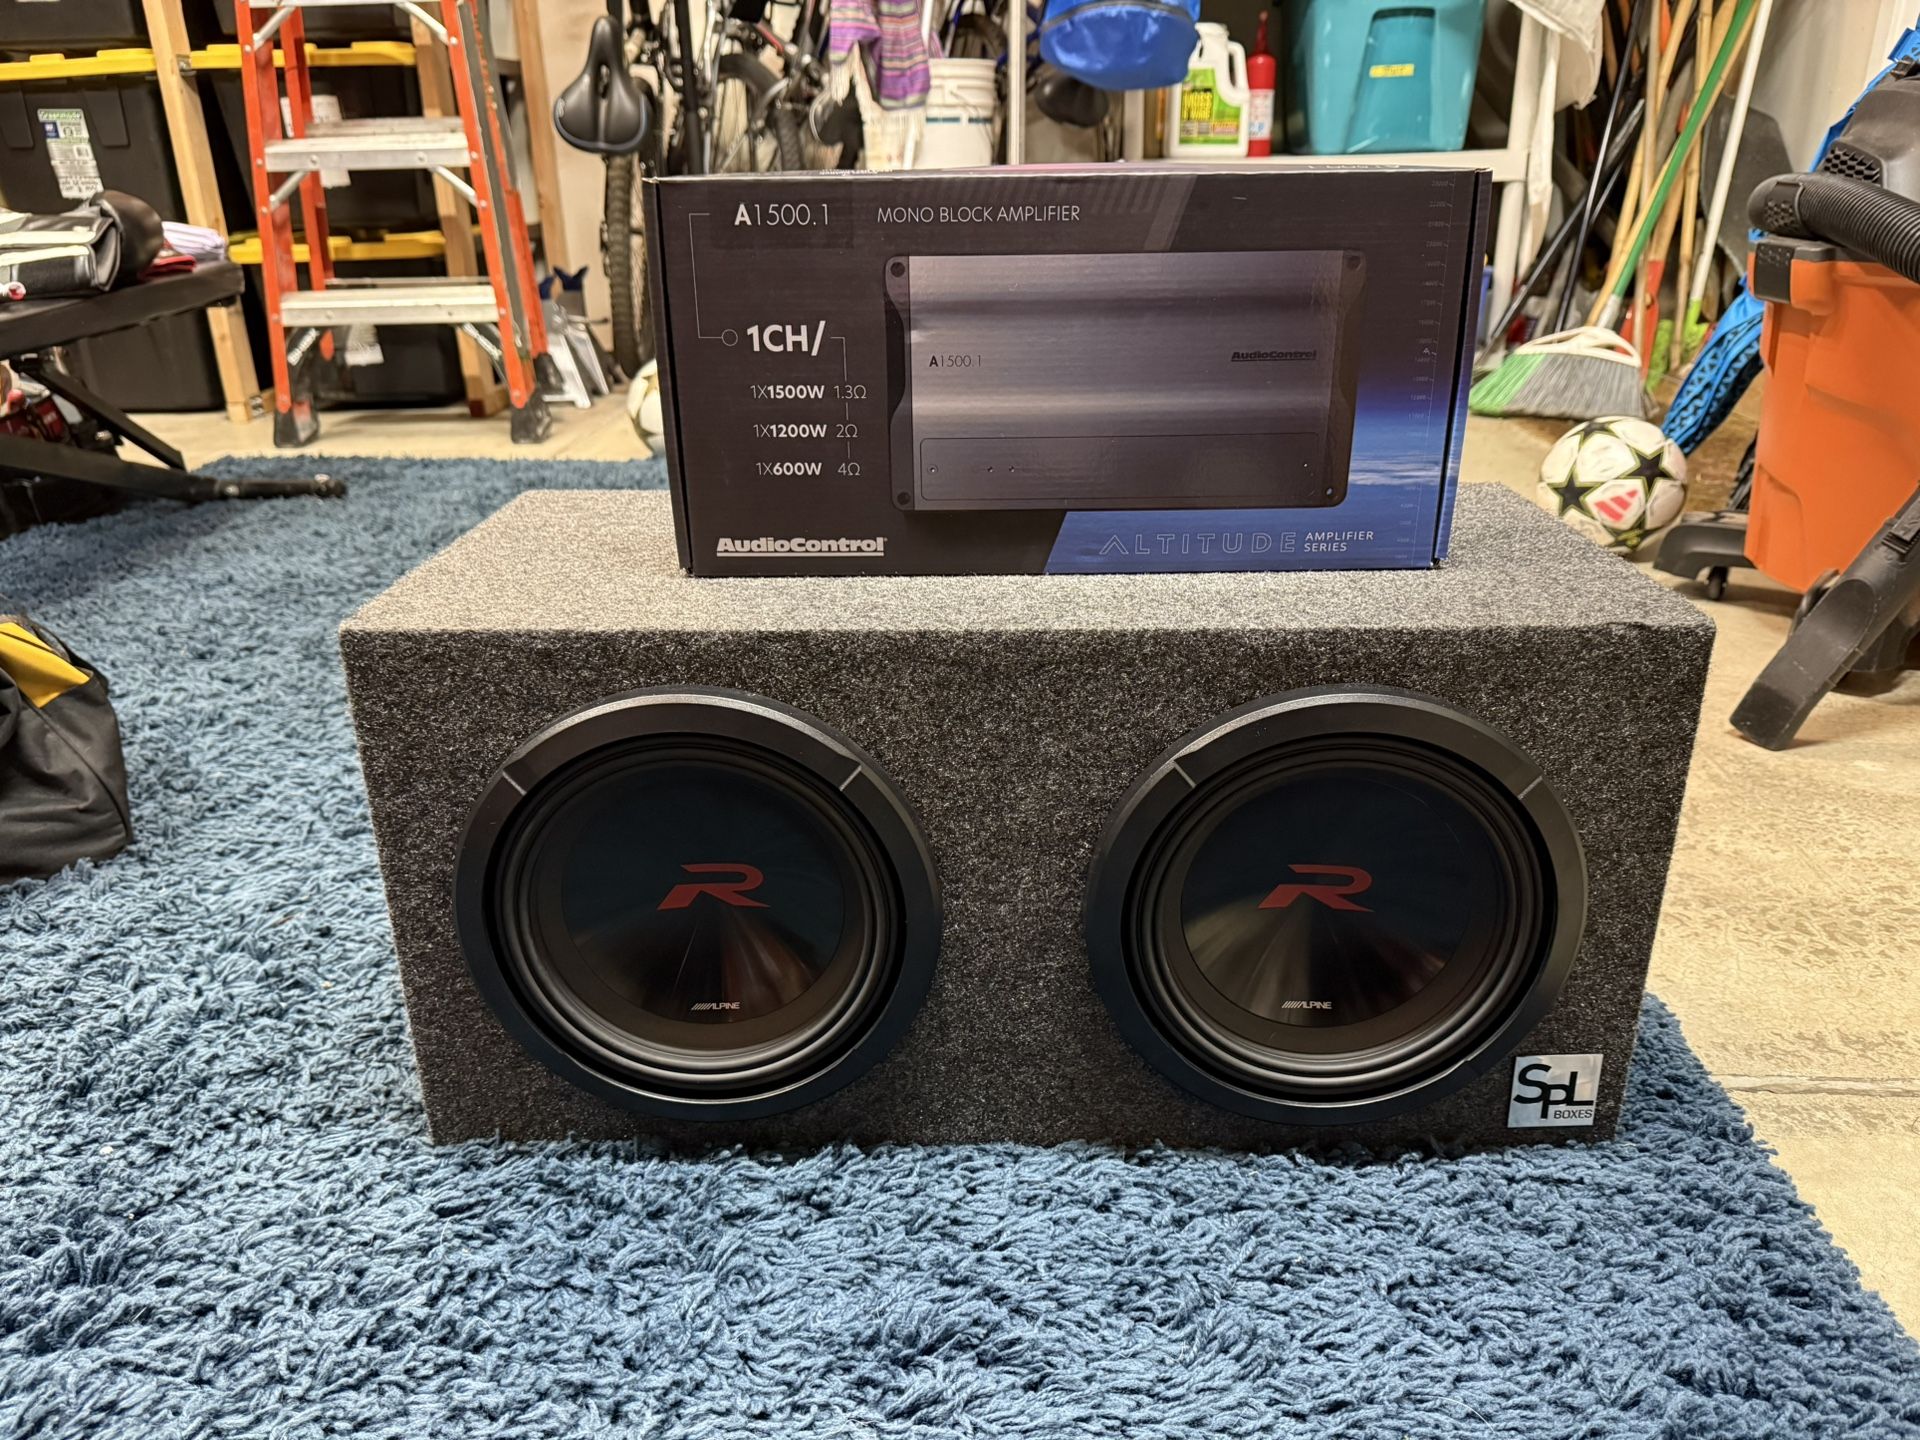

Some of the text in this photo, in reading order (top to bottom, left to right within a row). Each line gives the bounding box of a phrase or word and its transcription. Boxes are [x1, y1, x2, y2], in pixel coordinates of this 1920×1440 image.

[734, 203, 828, 226] A1500.1
[877, 205, 1081, 223] MONO BLOCK AMPLIFIER
[746, 320, 826, 357] 1CH/
[929, 354, 982, 368] A1500.1
[1230, 350, 1317, 362] AudioControl
[750, 384, 867, 399] 1X1500W 1.3Ω
[753, 423, 858, 438] 1X1200W 2Ω
[756, 461, 861, 476] 1X600W 4Ω
[1099, 531, 1297, 555] ALTITUDE
[1305, 530, 1374, 541] AMPLIFIER
[716, 536, 885, 557] AudioControl
[1304, 541, 1347, 552] SERIES
[1553, 1109, 1593, 1119] BOXES
